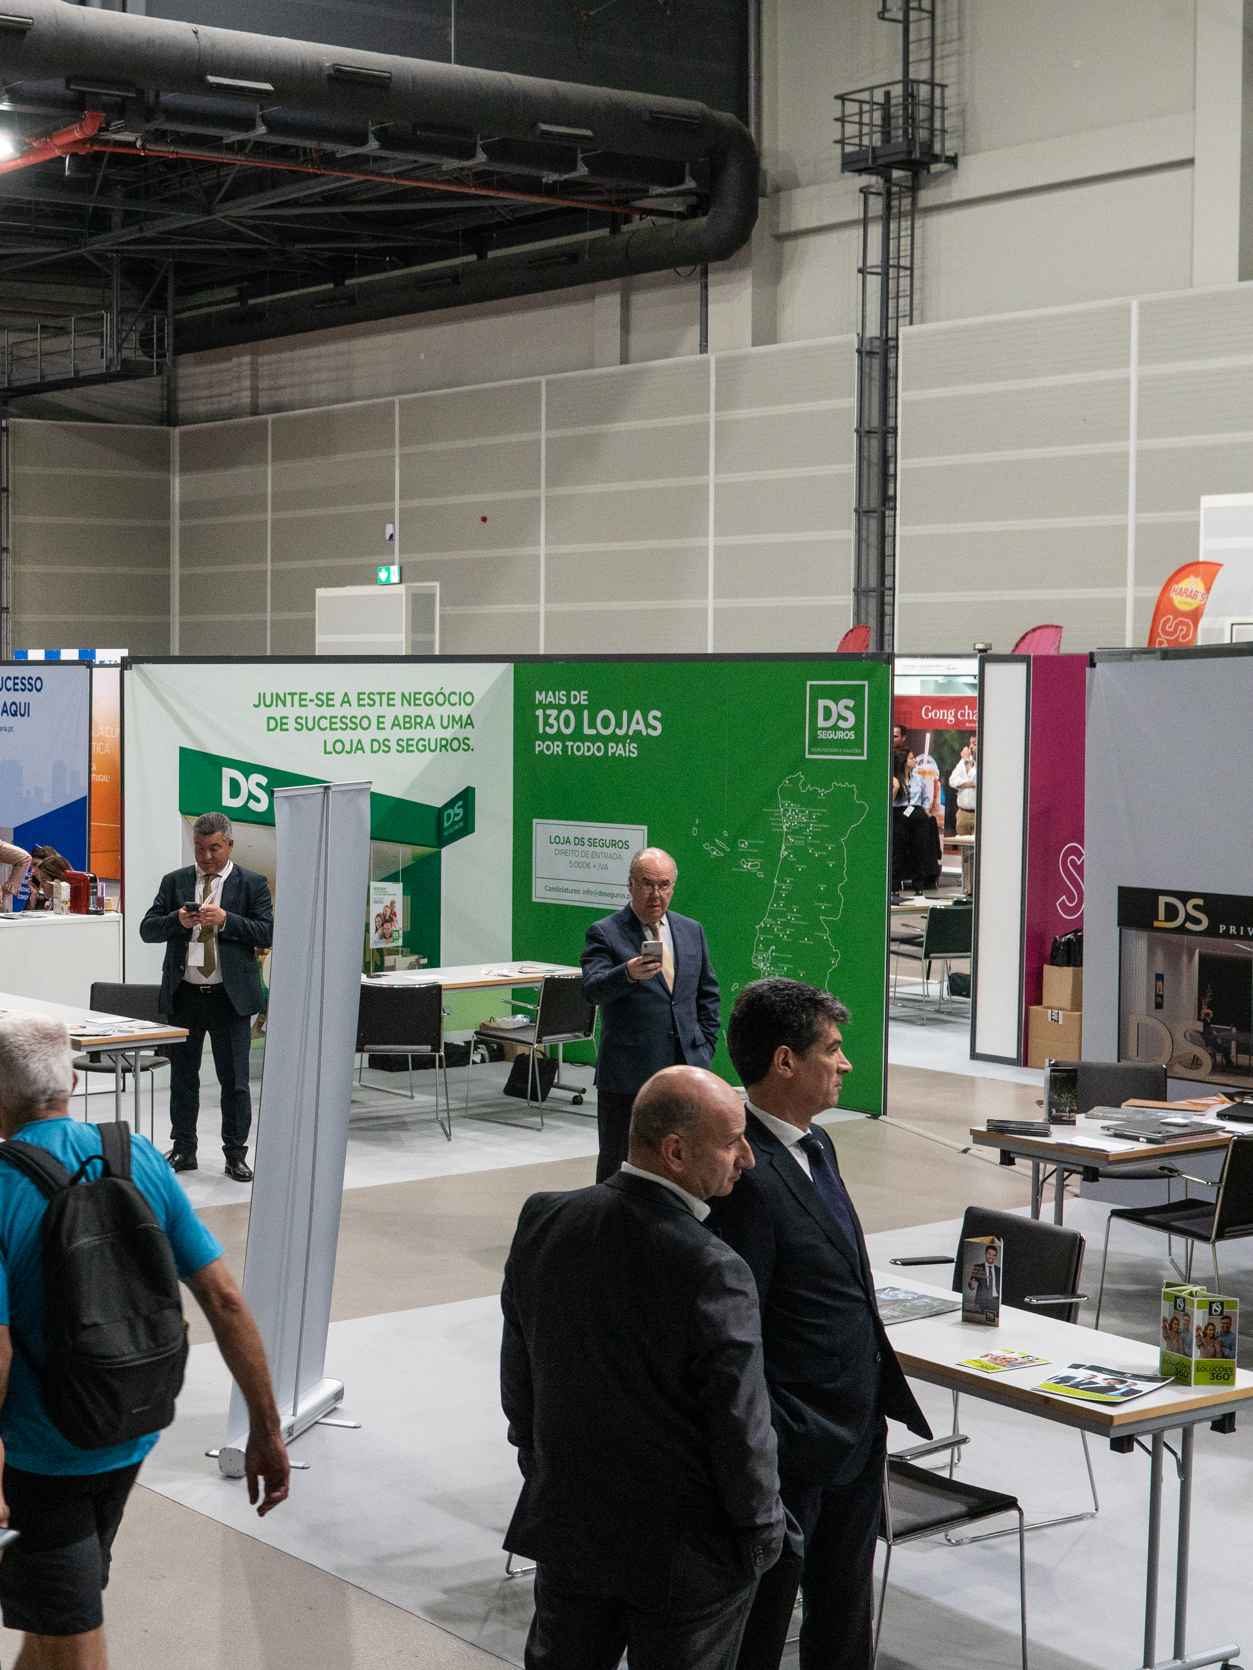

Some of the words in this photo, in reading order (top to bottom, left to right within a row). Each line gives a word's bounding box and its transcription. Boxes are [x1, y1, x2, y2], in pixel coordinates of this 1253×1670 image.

[252, 692, 336, 708] JUNTE-SE
[340, 692, 352, 707] A
[357, 692, 396, 707] ESTE
[401, 687, 475, 707] NEGÓCIO
[535, 690, 567, 704] MAIS
[570, 690, 588, 704] DE
[1, 701, 31, 717] AQUI
[817, 698, 856, 729] DS
[921, 705, 955, 724] Gong
[957, 705, 978, 720] cha
[266, 716, 290, 732] DE
[294, 715, 372, 732] SUCESSO
[376, 715, 386, 730] E
[390, 714, 436, 730] ABRA
[440, 714, 475, 729] UMA
[535, 709, 575, 735] 130
[583, 709, 662, 736] LOJAS
[817, 730, 855, 740] SEGUROS
[92, 742, 110, 754] TICA
[324, 738, 365, 755] LOJA
[370, 738, 391, 754] DS
[395, 737, 475, 754] SEGUROS.
[535, 740, 562, 755] POR
[566, 741, 605, 756] TODO
[608, 739, 638, 757] PAÍS
[222, 766, 269, 813] DS
[444, 800, 464, 829] DS
[549, 835, 571, 846] LOJA
[573, 837, 585, 847] DS
[587, 837, 630, 850] SEGUROS
[554, 849, 580, 857] DIREITO
[581, 850, 590, 858] DE
[598, 863, 609, 871] IVA
[544, 885, 581, 895] Candidaturas:
[1153, 895, 1209, 931] DS
[1196, 1365, 1234, 1373] SOLUÇÕES
